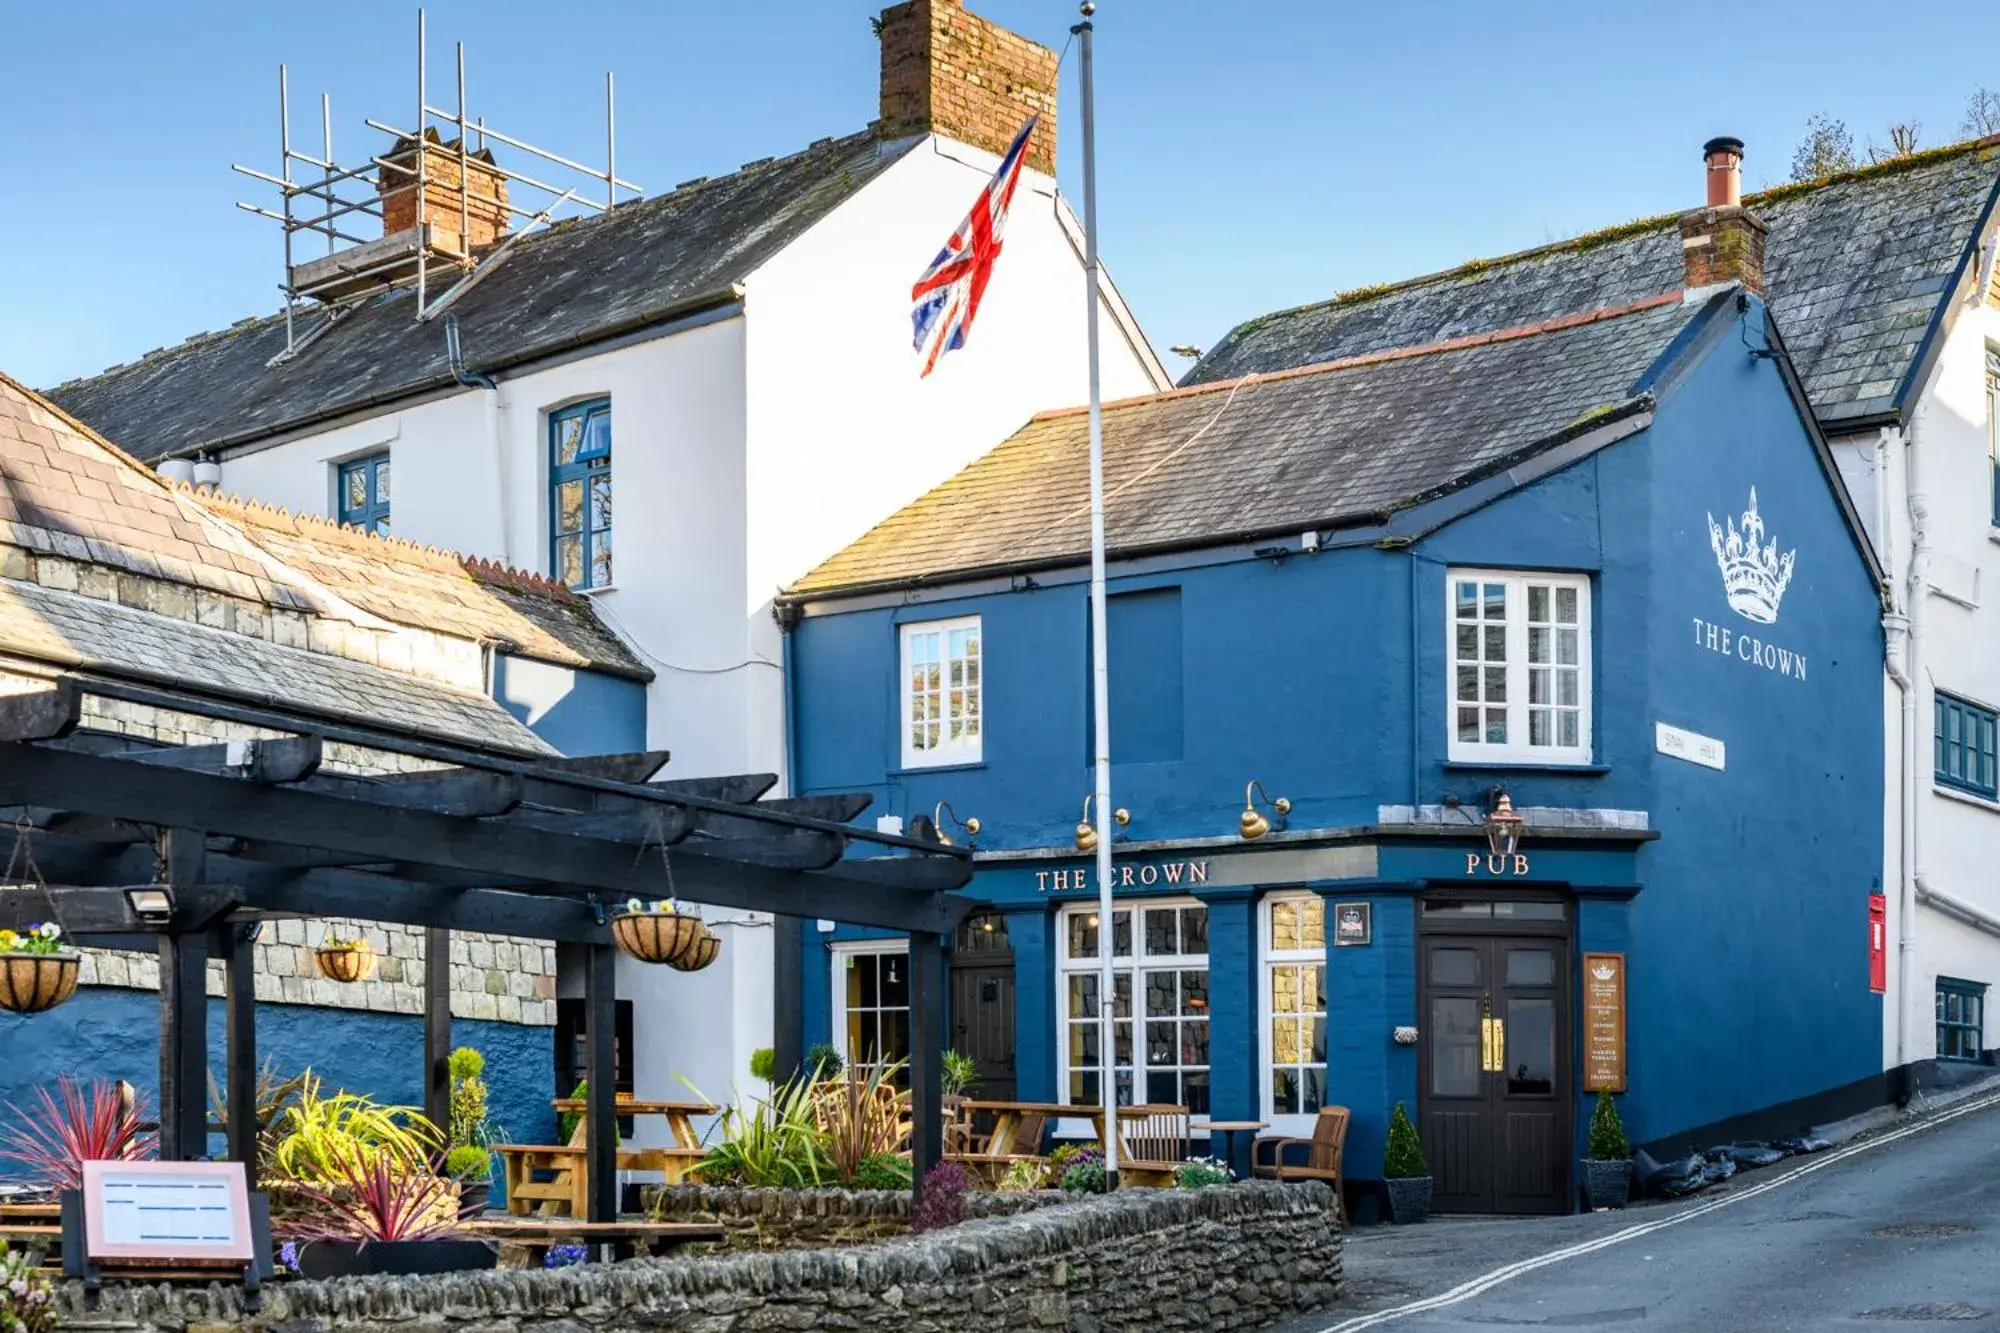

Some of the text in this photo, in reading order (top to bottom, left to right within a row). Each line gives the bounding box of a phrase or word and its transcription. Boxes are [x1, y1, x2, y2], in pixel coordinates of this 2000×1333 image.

[1692, 618, 1807, 682] THE CROWN
[1466, 853, 1529, 875] PUB
[1036, 869, 1087, 891] THE
